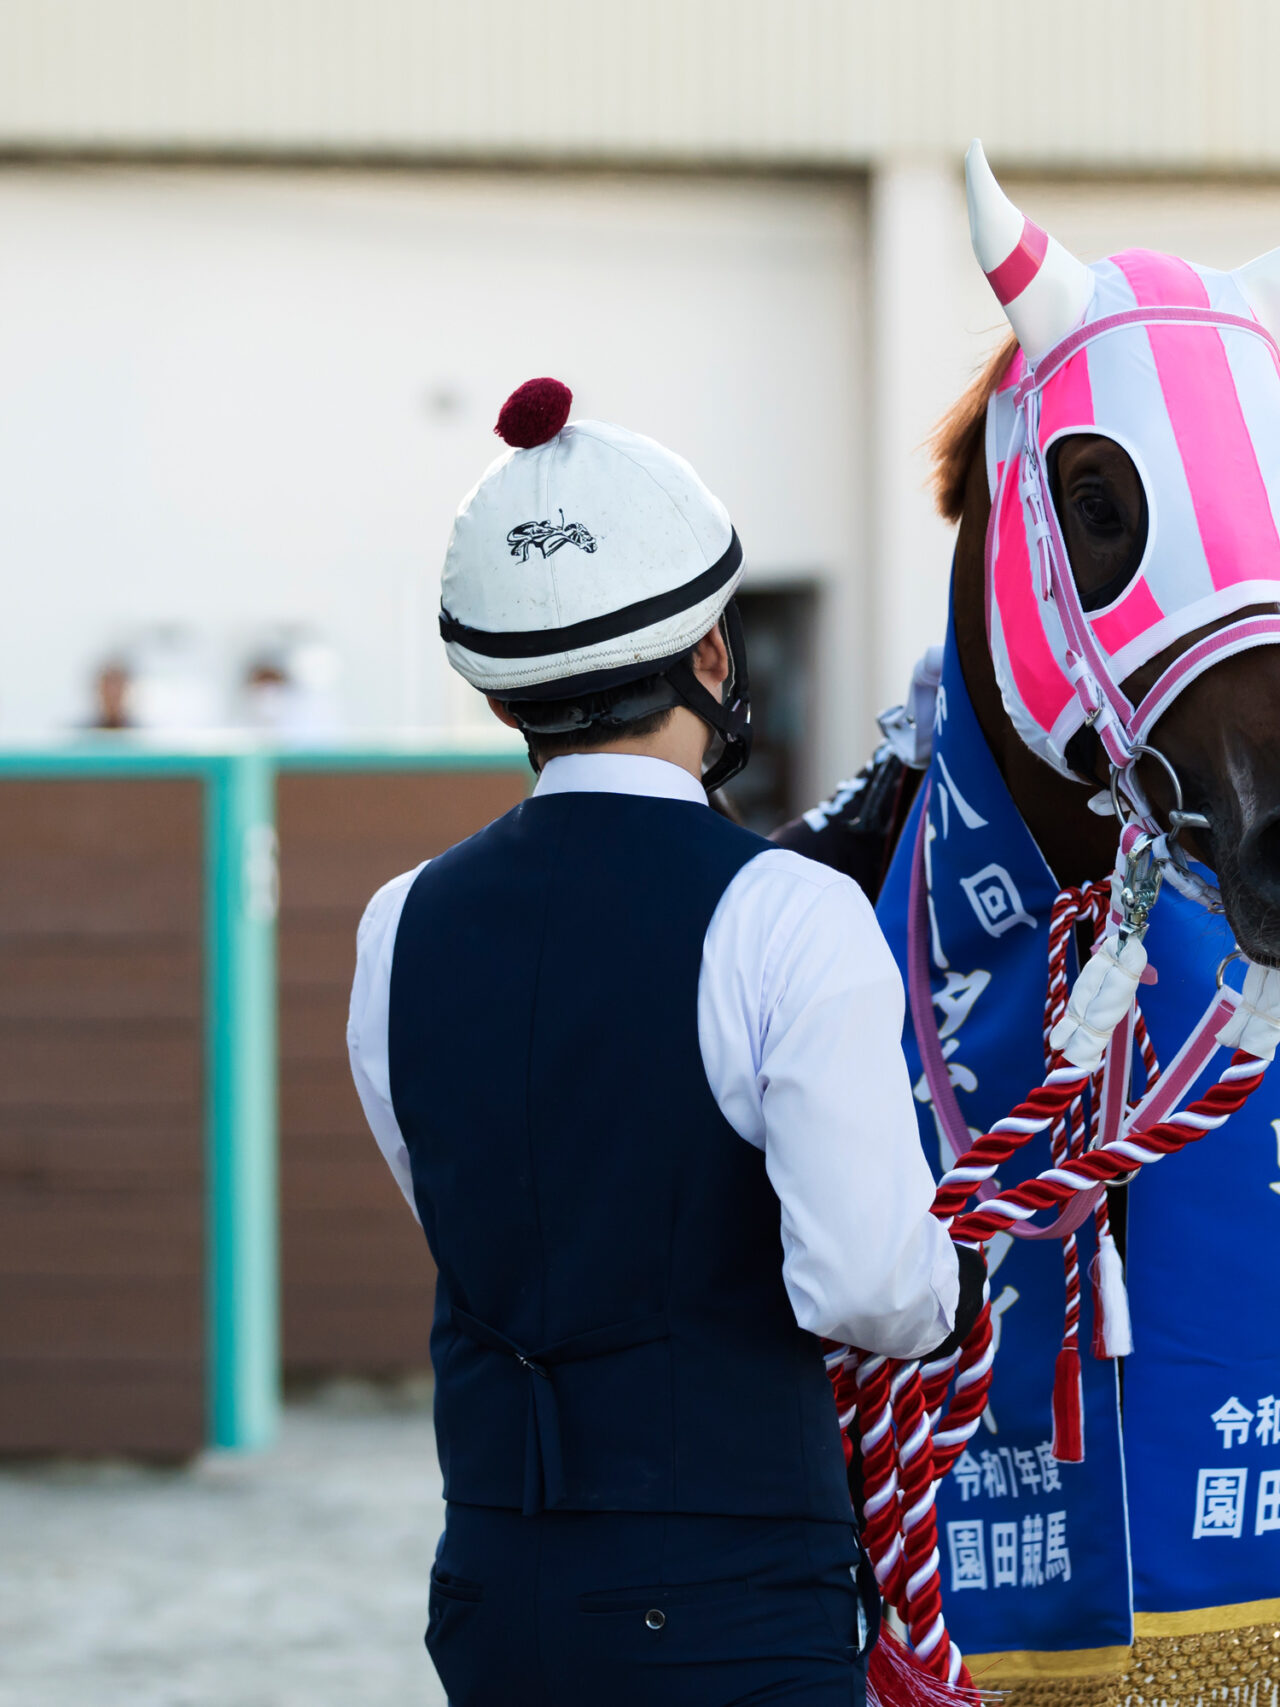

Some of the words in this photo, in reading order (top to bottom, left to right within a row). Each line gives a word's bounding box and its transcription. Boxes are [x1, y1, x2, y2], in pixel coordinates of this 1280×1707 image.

[952, 1440, 1063, 1501] 令和7年度
[946, 1510, 1071, 1592] 園田競馬
